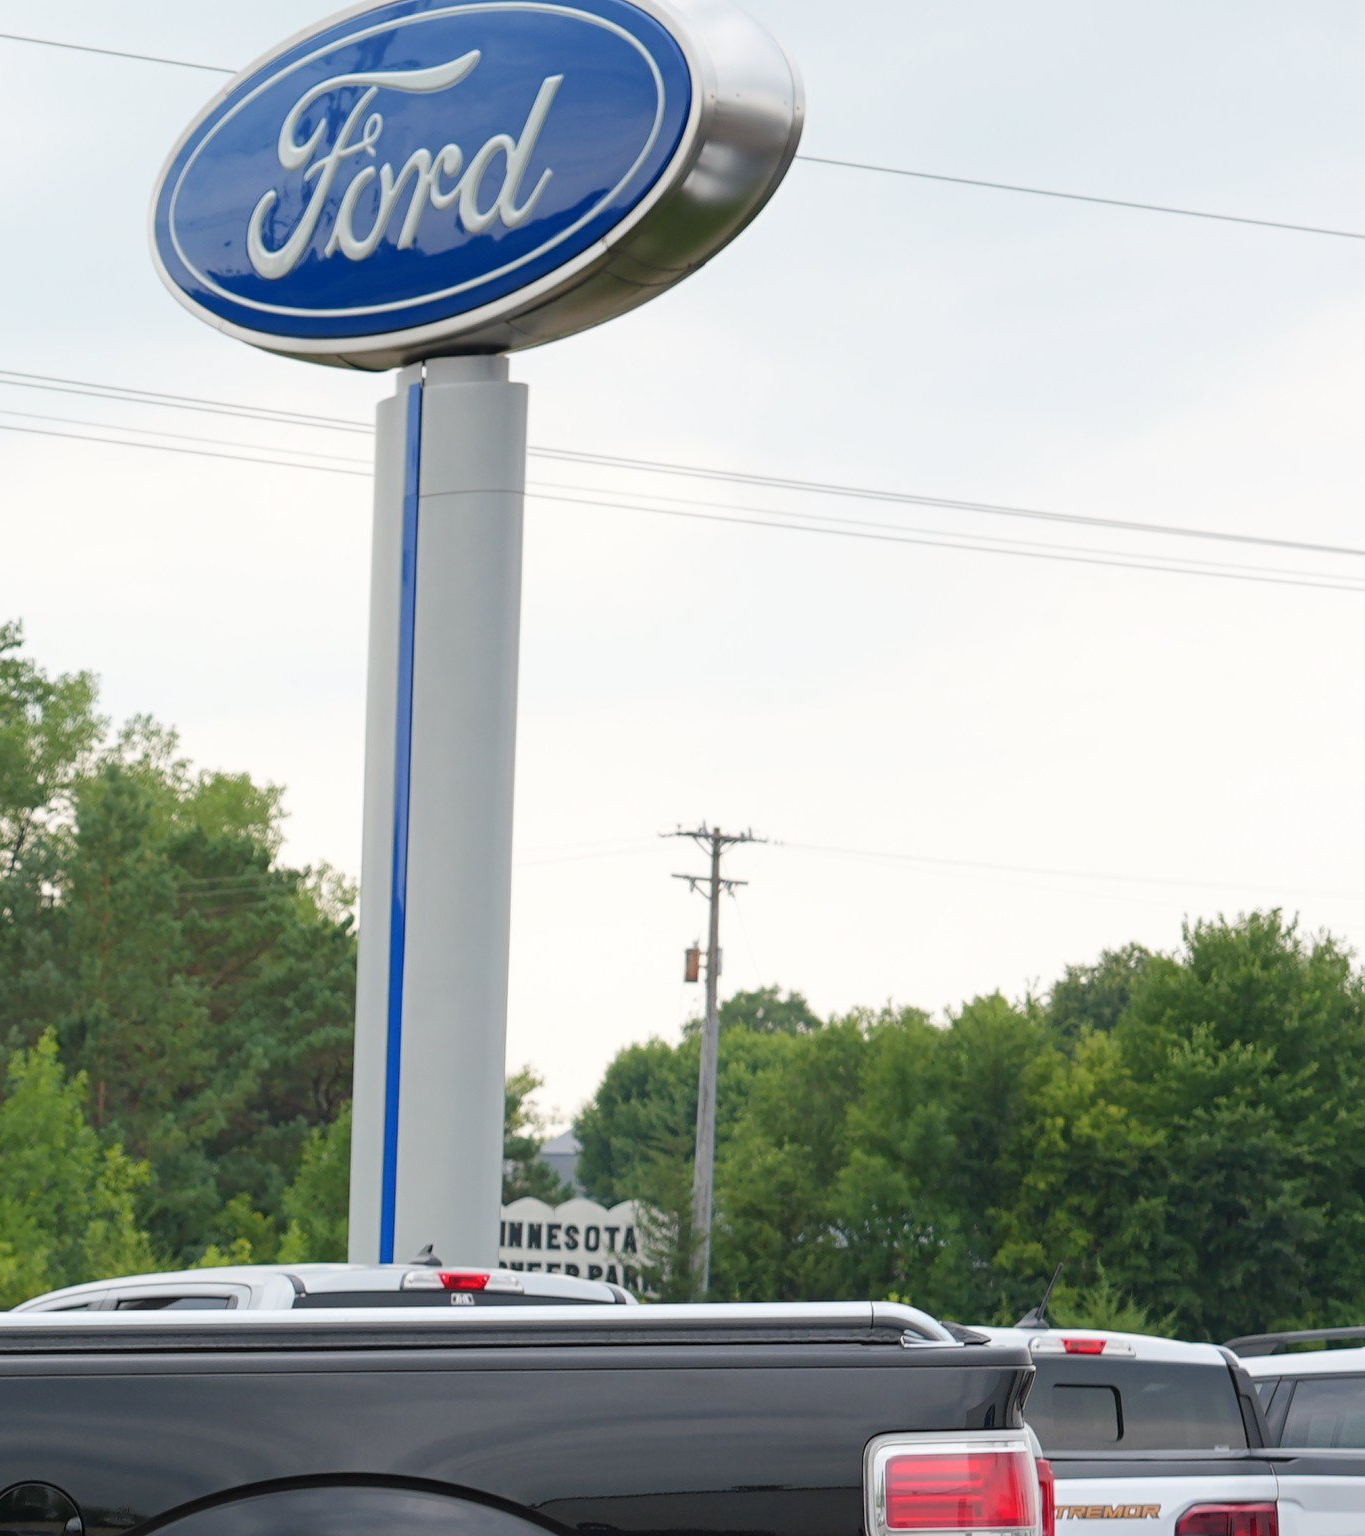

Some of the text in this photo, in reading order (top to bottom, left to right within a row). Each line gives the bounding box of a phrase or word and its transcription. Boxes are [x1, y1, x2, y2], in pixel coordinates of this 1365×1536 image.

[247, 49, 564, 279] Ford
[500, 1221, 637, 1253] INNESOTA
[1055, 1504, 1161, 1519] TREMOR
